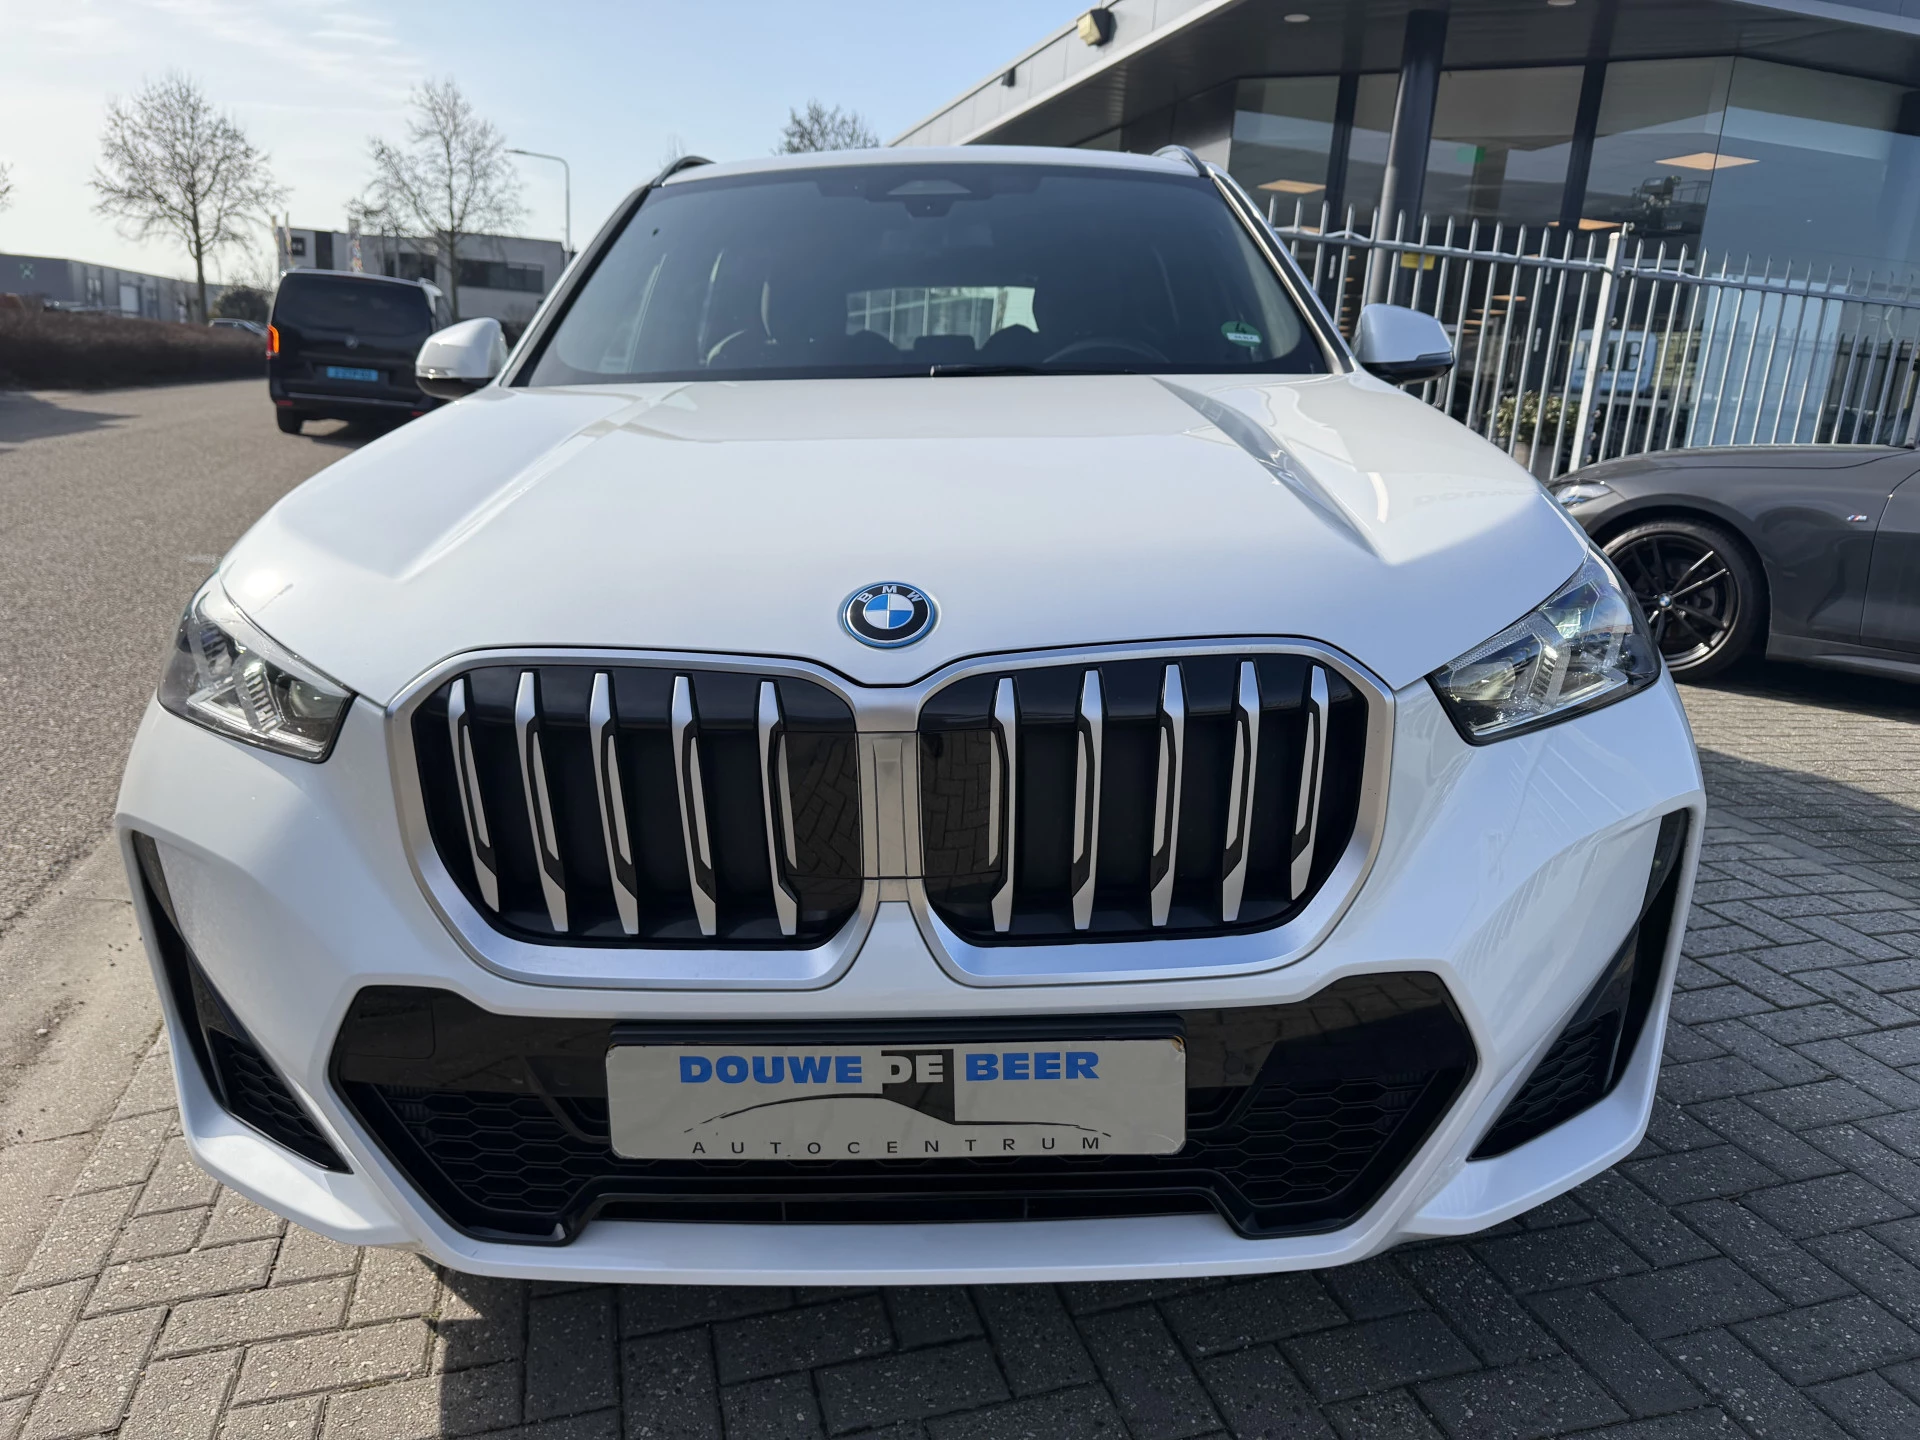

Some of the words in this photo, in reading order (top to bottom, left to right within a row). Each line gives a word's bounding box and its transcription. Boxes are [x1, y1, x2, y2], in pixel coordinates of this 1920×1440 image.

[857, 585, 923, 603] BMW
[679, 1055, 863, 1084] DOUWE
[882, 1054, 944, 1084] DE
[965, 1051, 1100, 1082] BEER
[692, 1137, 1100, 1155] AUTOCENTRUM
